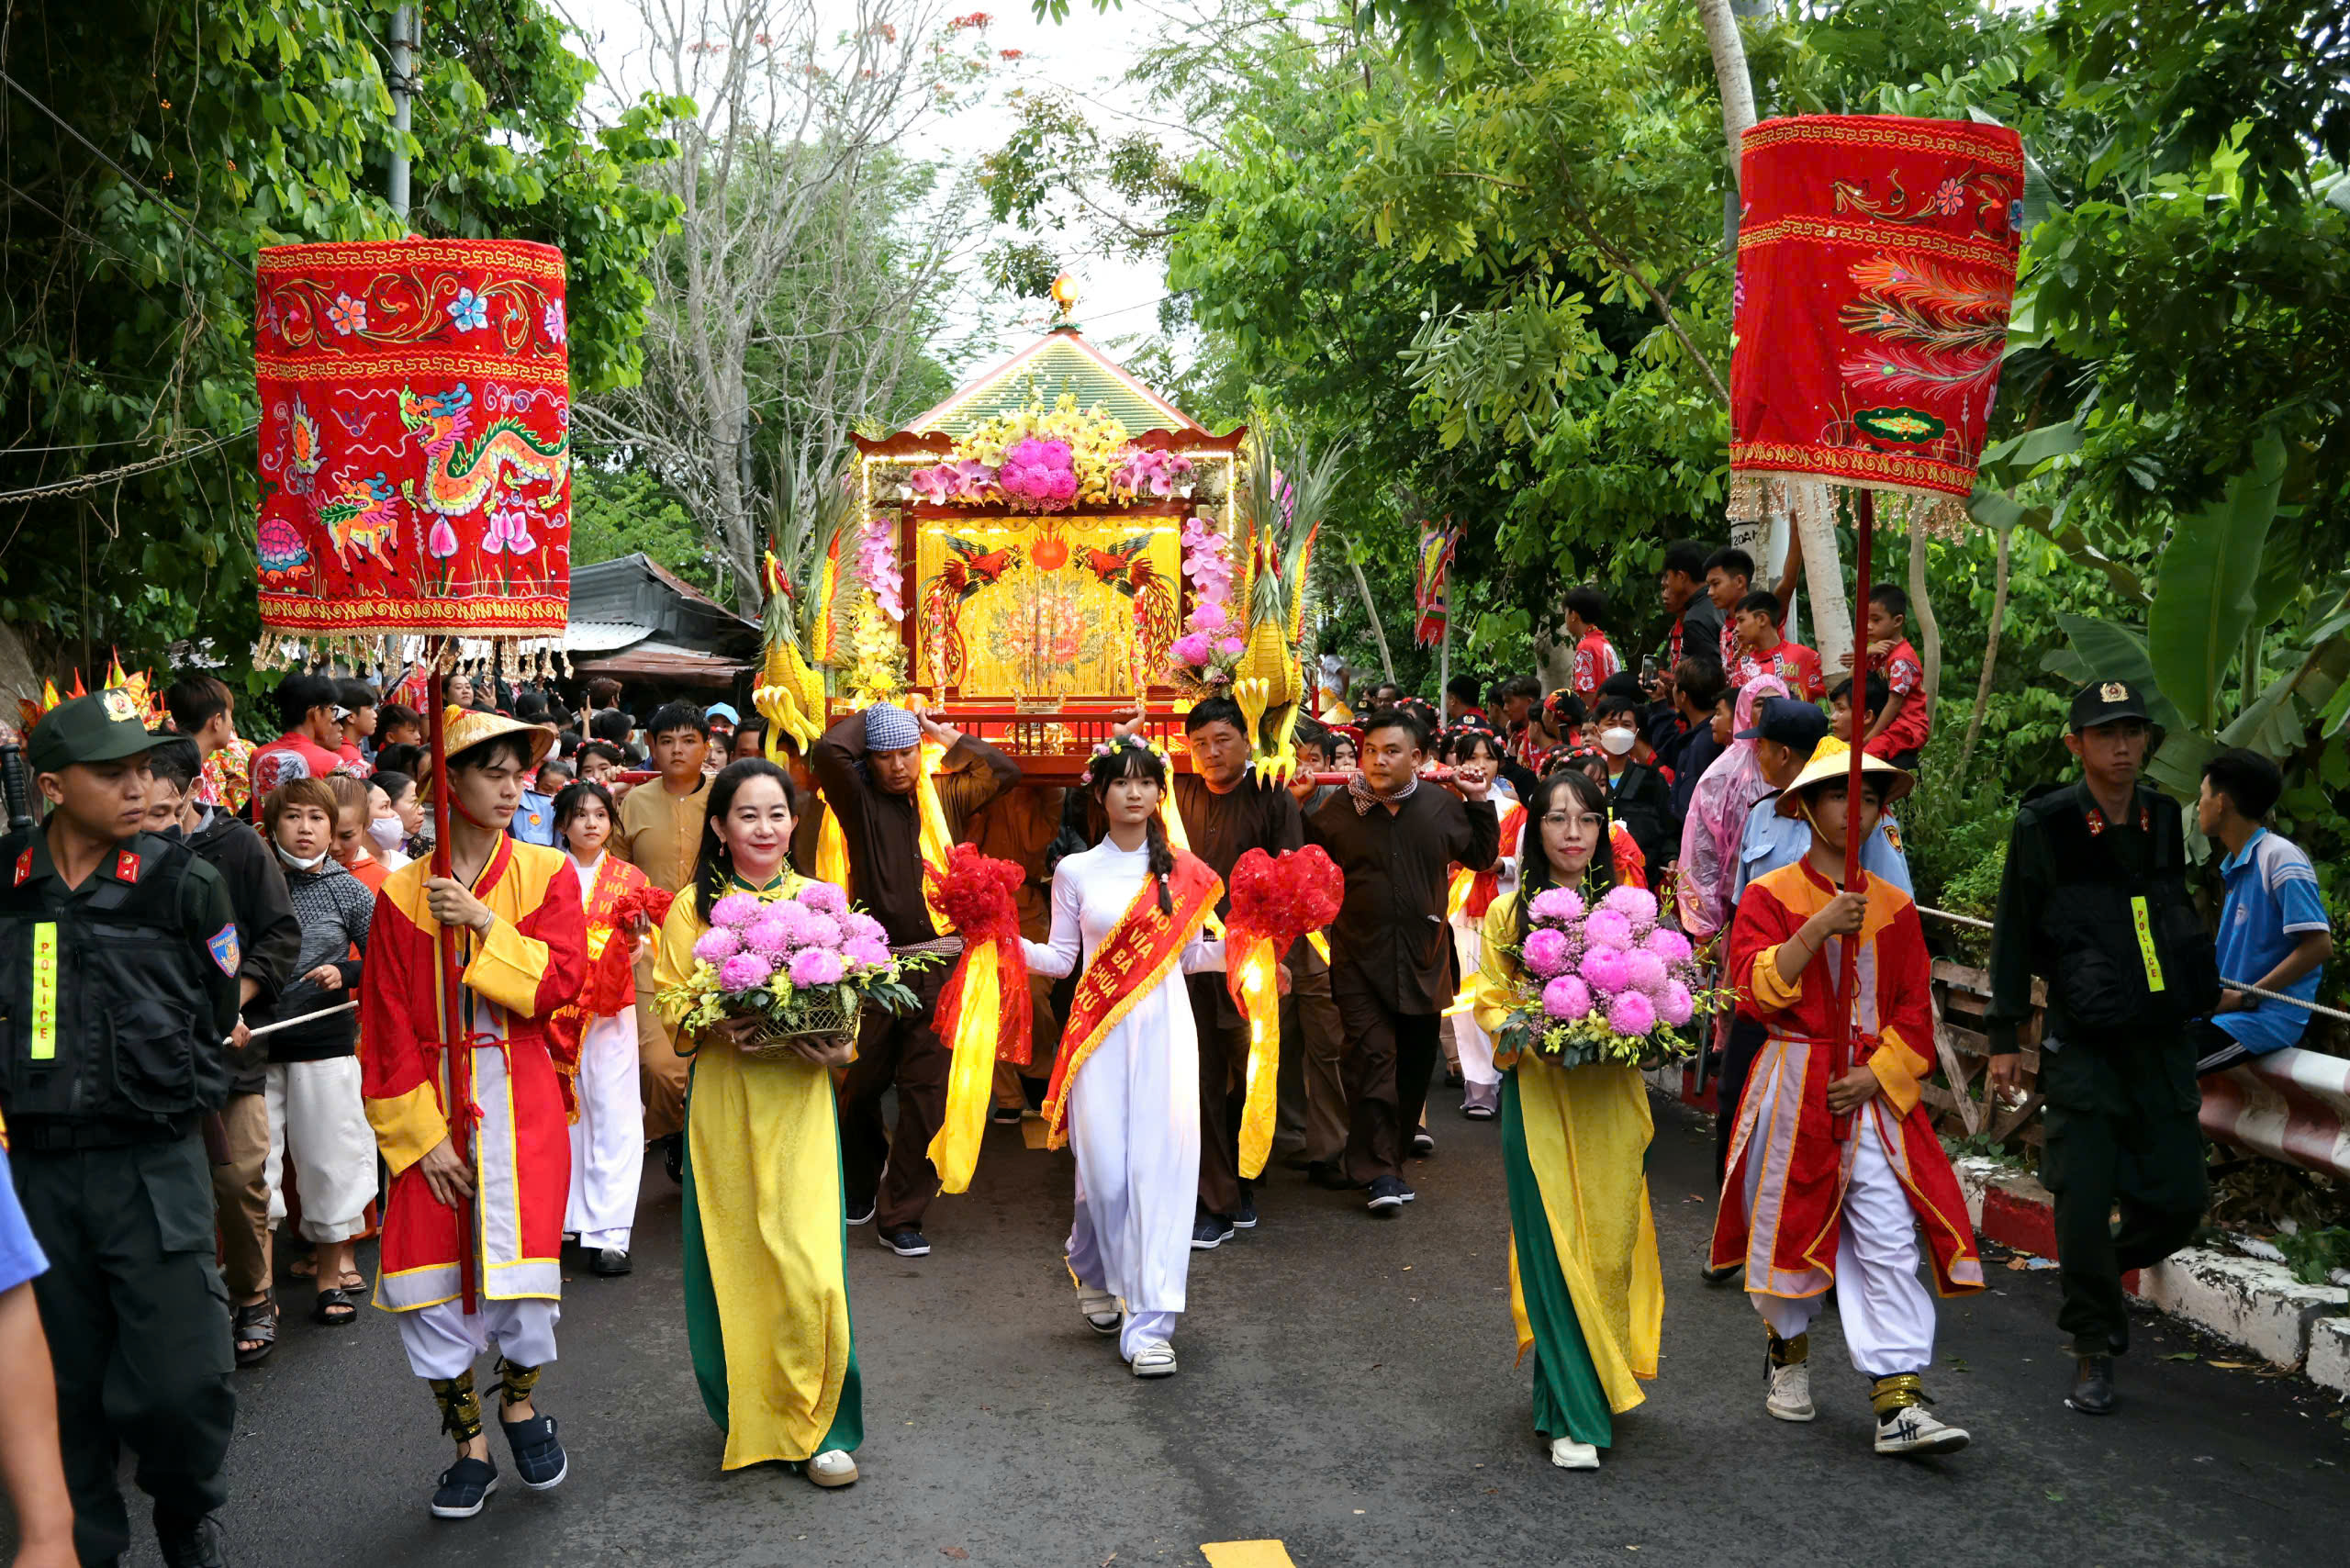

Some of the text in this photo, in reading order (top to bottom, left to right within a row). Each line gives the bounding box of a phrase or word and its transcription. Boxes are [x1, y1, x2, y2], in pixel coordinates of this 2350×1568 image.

[599, 900, 614, 914] VÍ
[1129, 926, 1154, 959] VÍA
[2138, 910, 2156, 978] POLICE
[1111, 948, 1136, 976] BÀ
[39, 942, 50, 1039] POLICE
[1091, 963, 1118, 999] CHÚA
[1076, 987, 1100, 1013] XỨ
